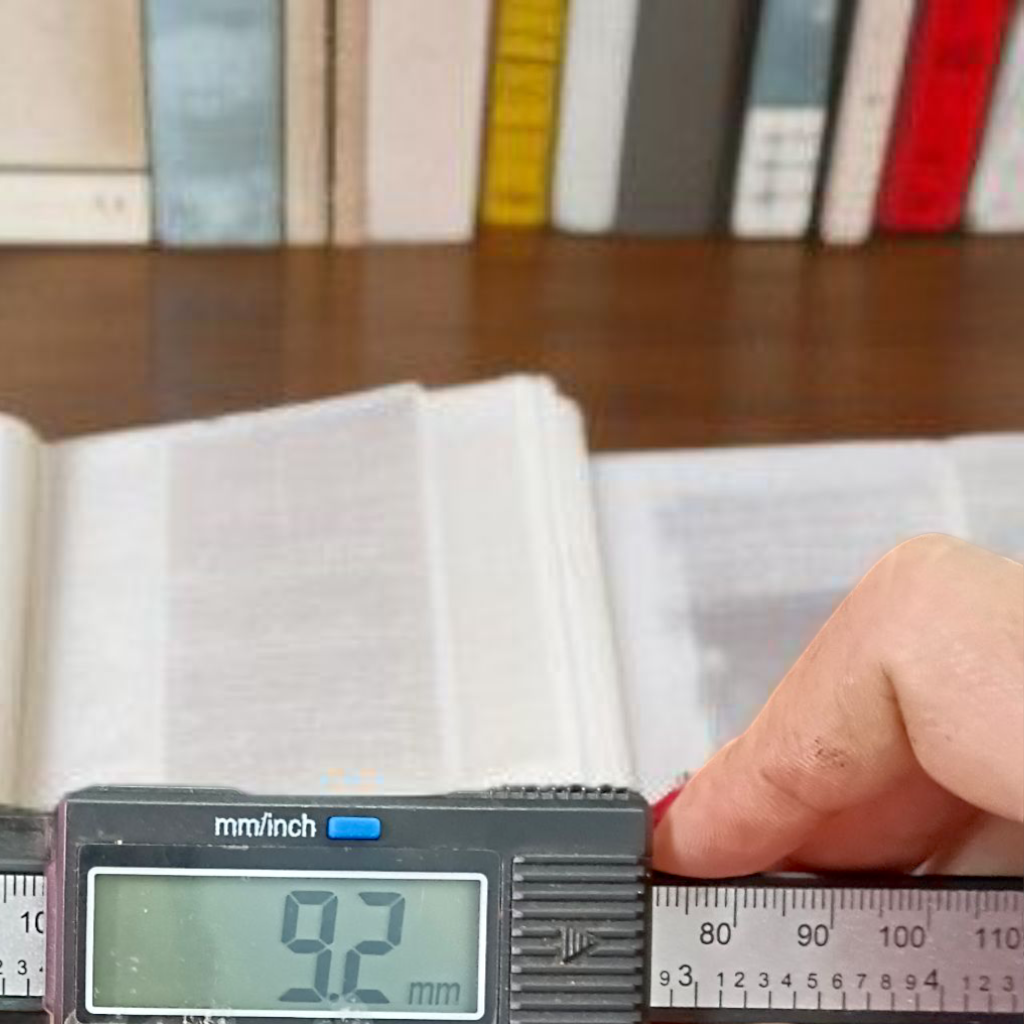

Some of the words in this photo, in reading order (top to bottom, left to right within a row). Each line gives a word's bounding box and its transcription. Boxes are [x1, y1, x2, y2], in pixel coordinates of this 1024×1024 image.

[214, 811, 317, 838] mm/inch
[278, 889, 407, 1005] 9.2
[407, 981, 461, 1006] mm
[699, 921, 732, 946] 80
[797, 923, 830, 947] 90
[879, 925, 926, 949] 100
[975, 926, 1022, 950] 110
[17, 959, 28, 976] 3
[659, 970, 671, 987] 9
[678, 963, 693, 987] 3
[716, 972, 724, 987] 1
[734, 971, 745, 988] 2
[758, 972, 770, 989] 3
[781, 973, 792, 988] 4
[807, 972, 818, 990] 5
[831, 972, 843, 990] 6
[856, 973, 868, 989] 7
[880, 973, 892, 991] 8
[905, 973, 917, 991] 9
[923, 968, 939, 991] 4
[962, 975, 970, 990] 1
[979, 975, 990, 992] 2
[1002, 975, 1015, 993] 3
